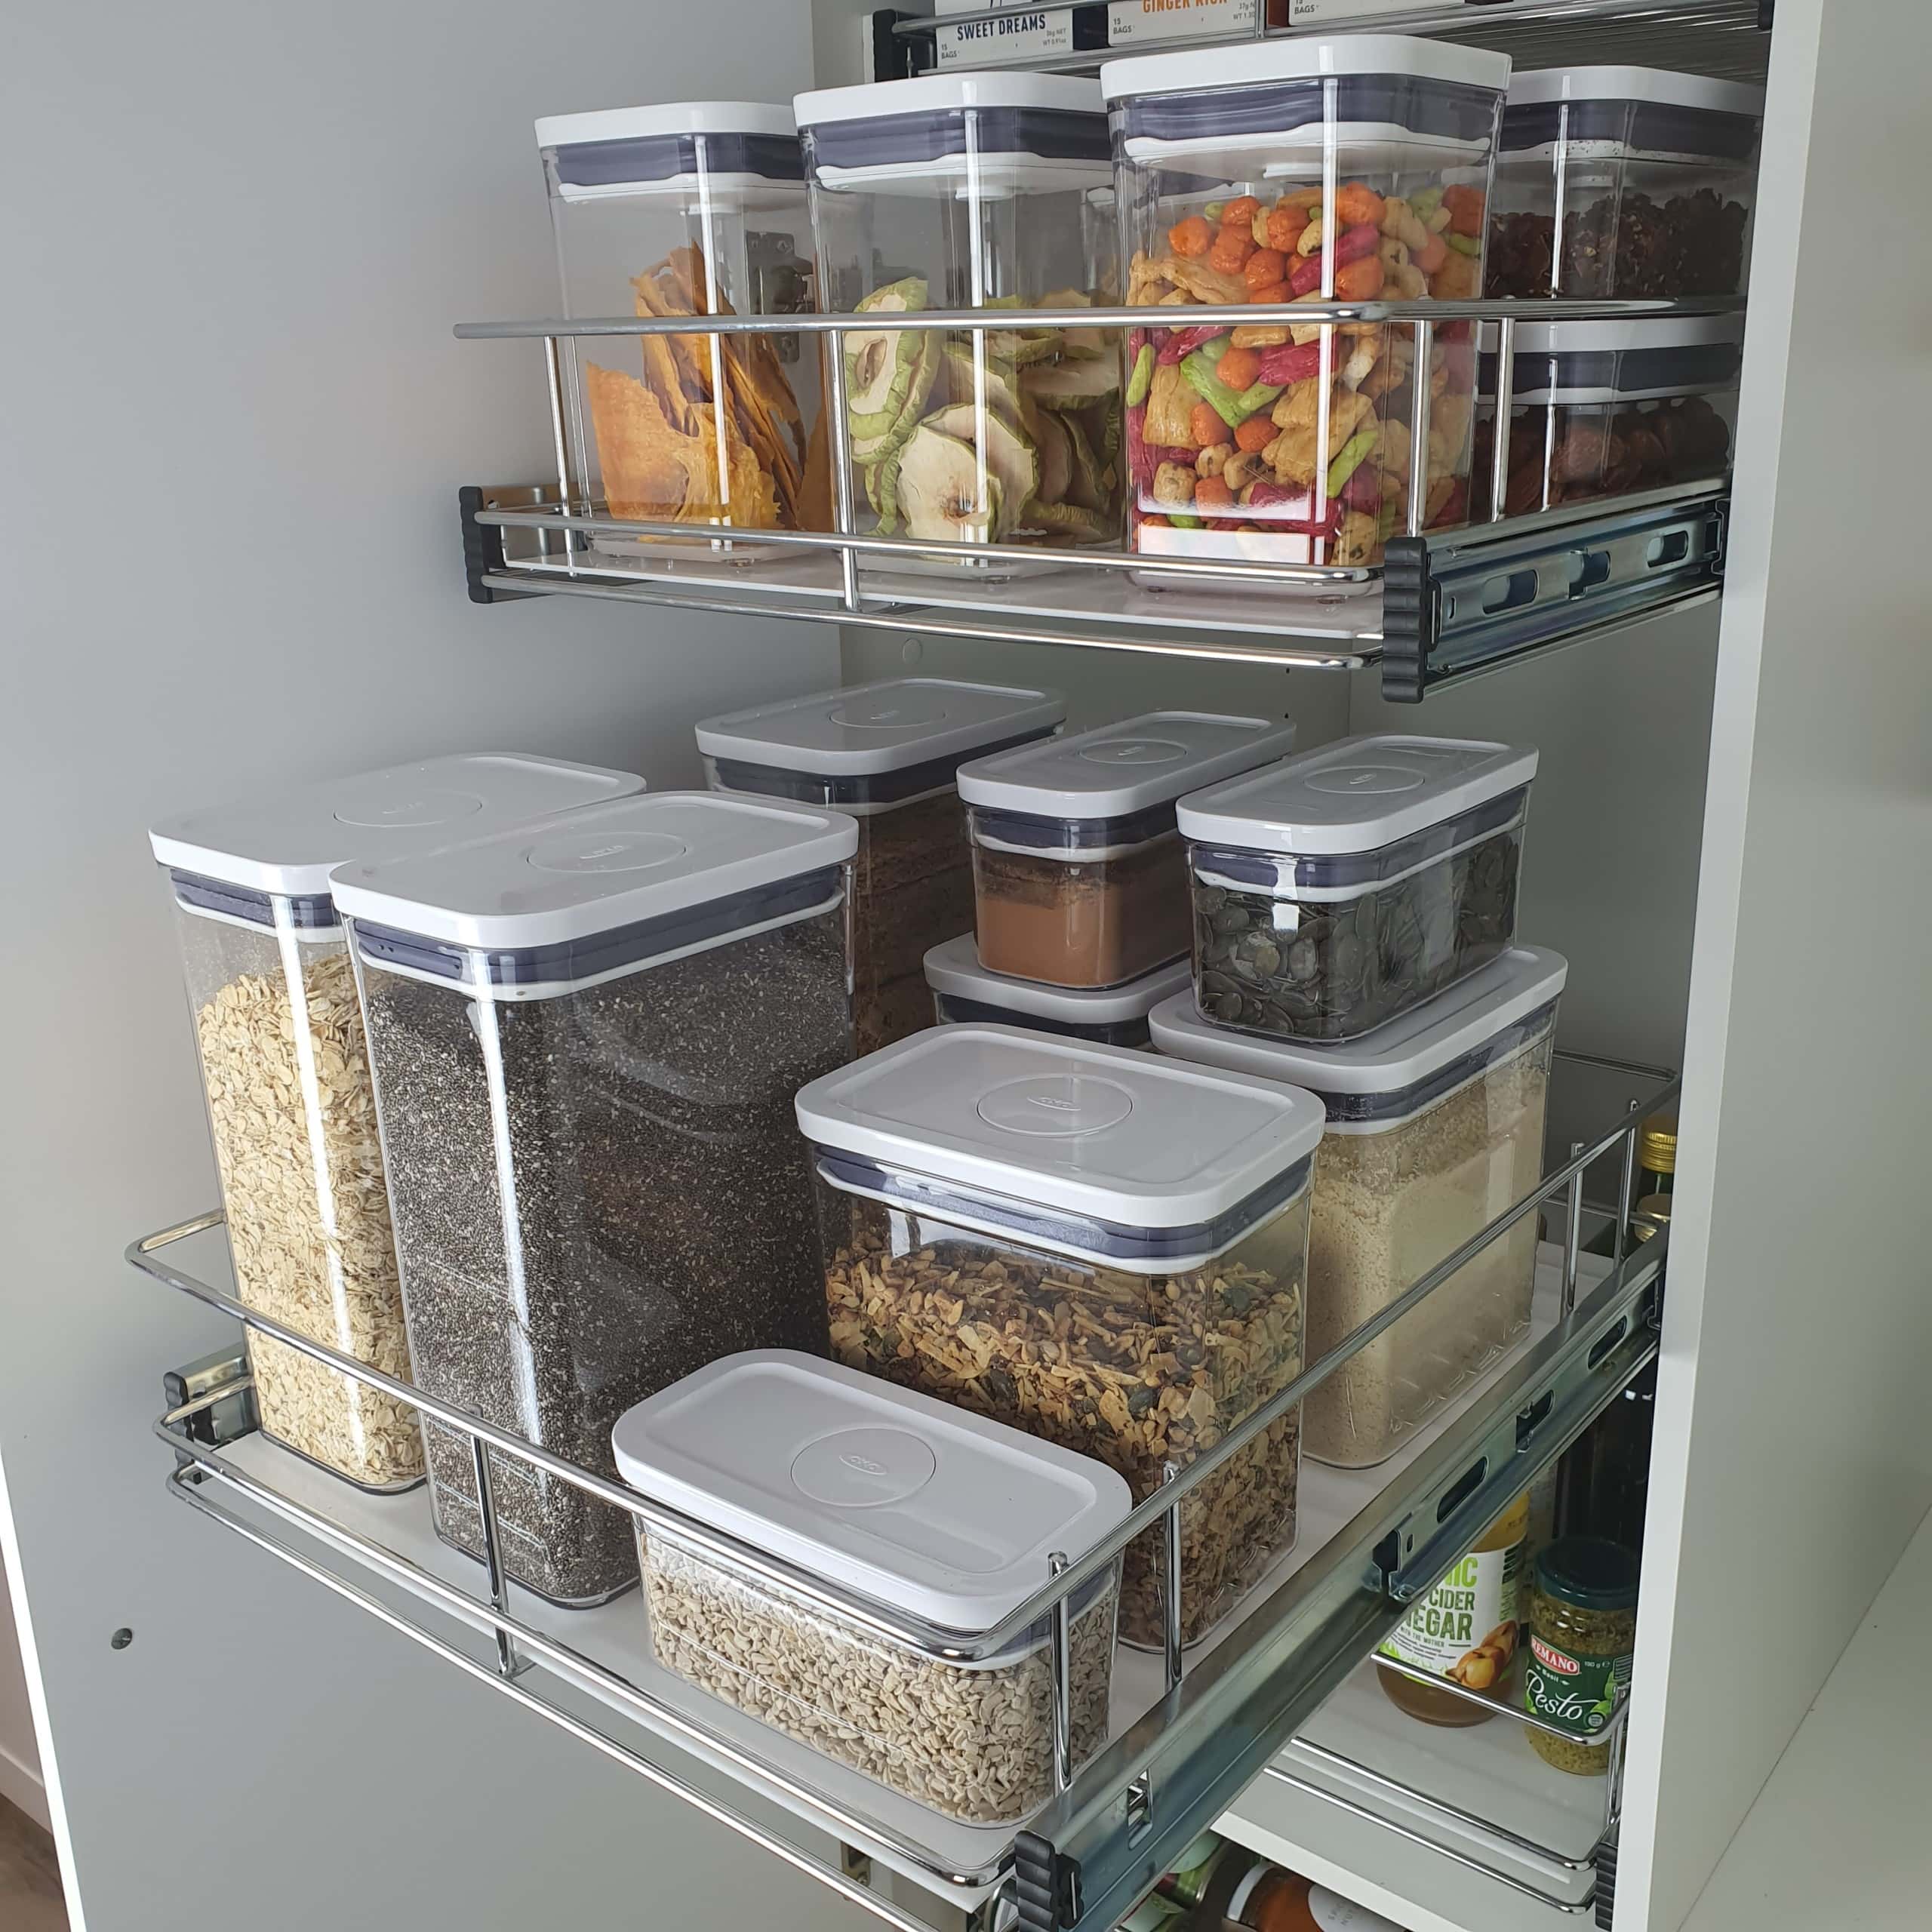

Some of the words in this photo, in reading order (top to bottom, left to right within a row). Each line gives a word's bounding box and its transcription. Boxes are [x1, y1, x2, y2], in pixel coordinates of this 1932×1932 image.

[1294, 5, 1315, 14] BAGS
[957, 21, 995, 41] SWEET
[998, 14, 1045, 35] DREAMS
[1113, 26, 1132, 34] BAGS
[941, 50, 957, 59] BAGS
[1429, 1588, 1475, 1611] CIDER
[1532, 1638, 1578, 1672] REMANO
[1542, 1669, 1558, 1682] Basil
[1526, 1669, 1601, 1720] Pesto
